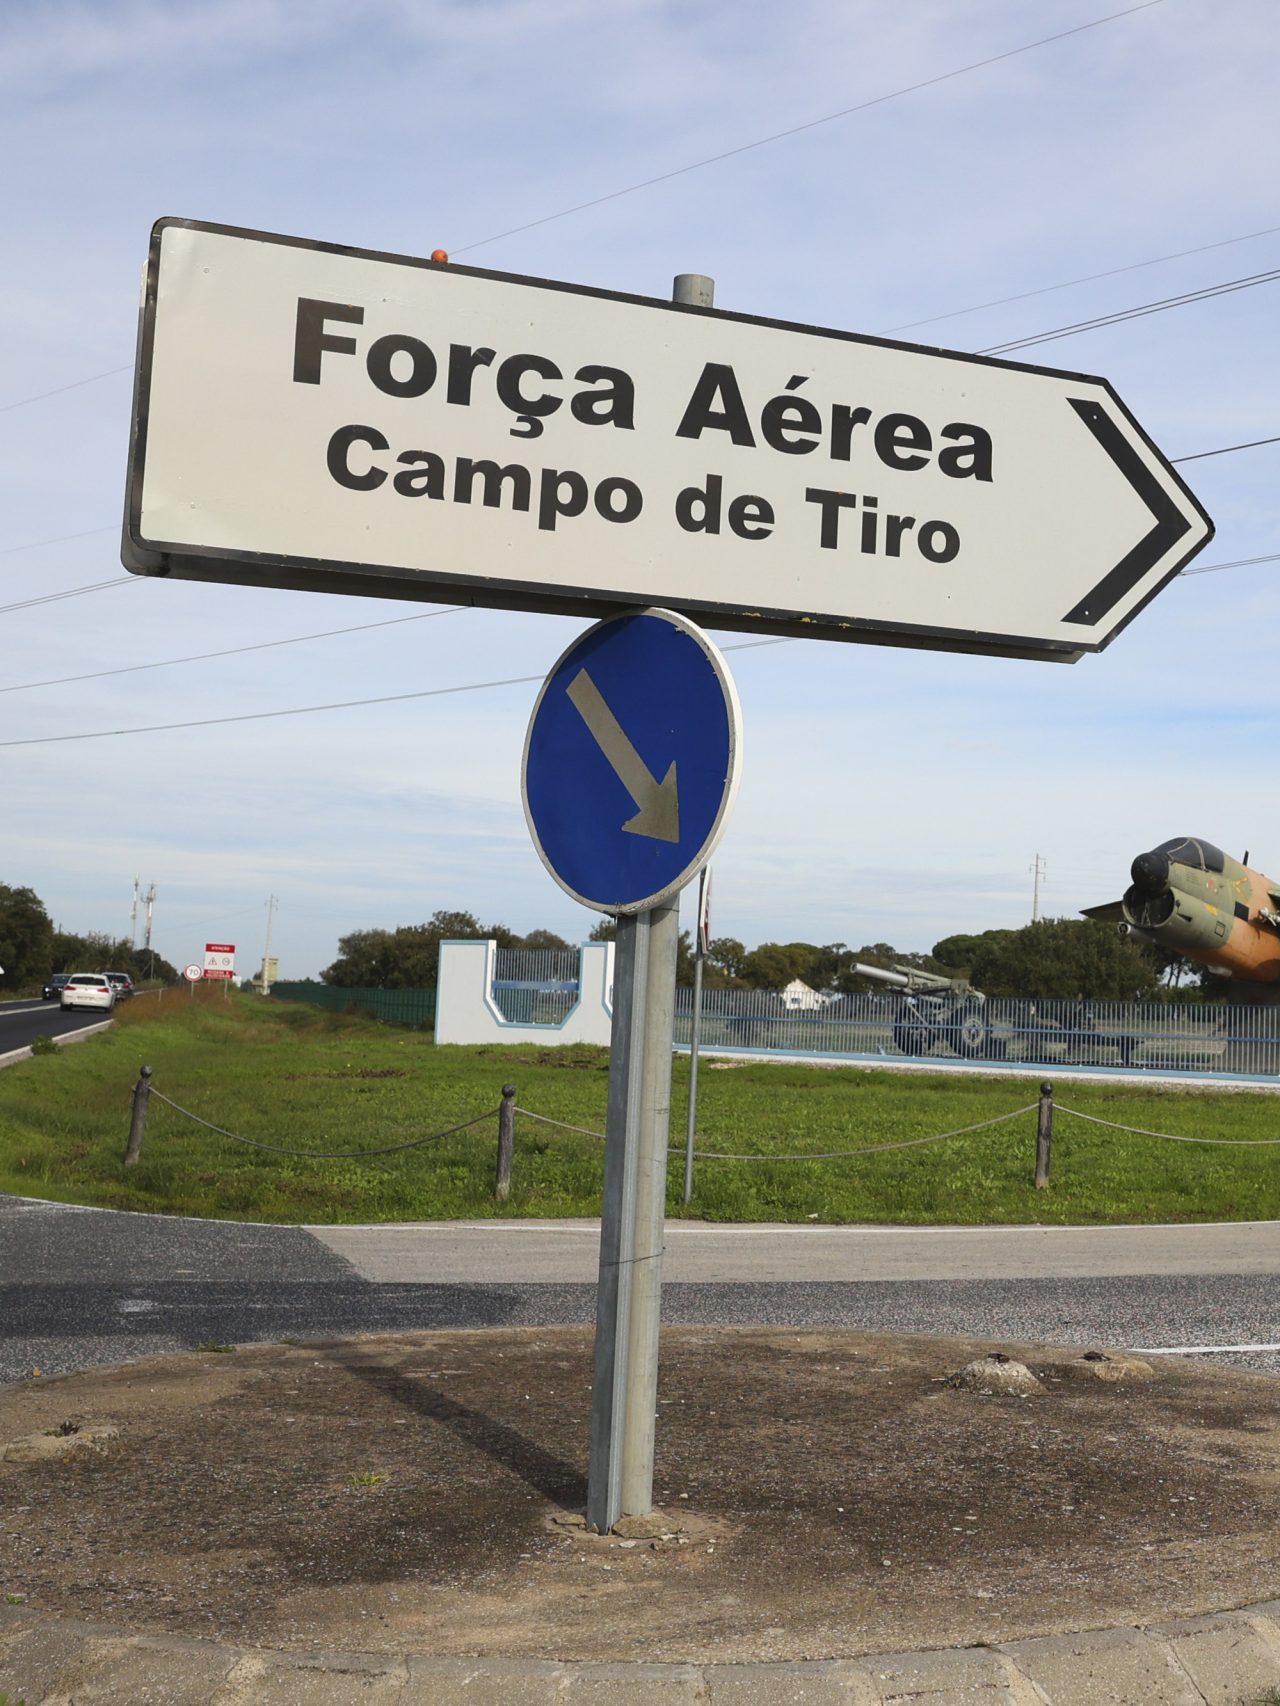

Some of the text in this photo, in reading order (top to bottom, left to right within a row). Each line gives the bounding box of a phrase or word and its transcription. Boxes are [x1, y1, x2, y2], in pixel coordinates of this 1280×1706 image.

[293, 297, 994, 483] Força Aérea
[326, 424, 961, 564] Campo de Tiro
